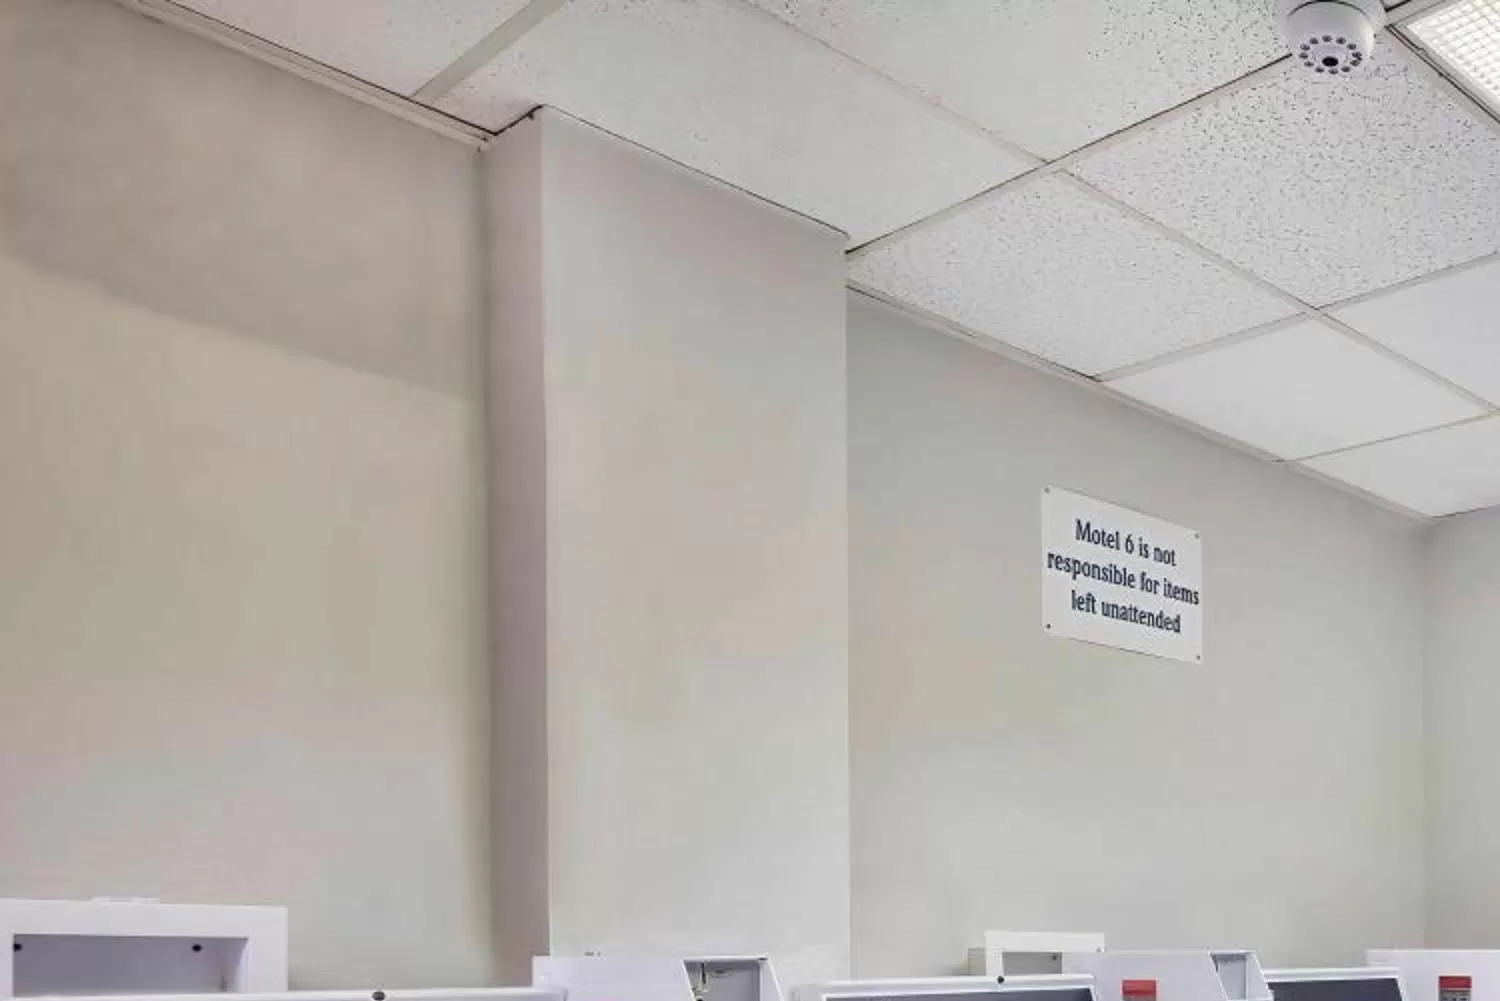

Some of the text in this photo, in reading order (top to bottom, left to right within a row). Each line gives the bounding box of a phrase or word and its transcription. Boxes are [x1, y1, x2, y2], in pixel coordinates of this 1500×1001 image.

[1075, 518, 1177, 567] Motel 6 is not
[1047, 551, 1200, 605] responsible for items
[1071, 589, 1181, 633] left unattended
